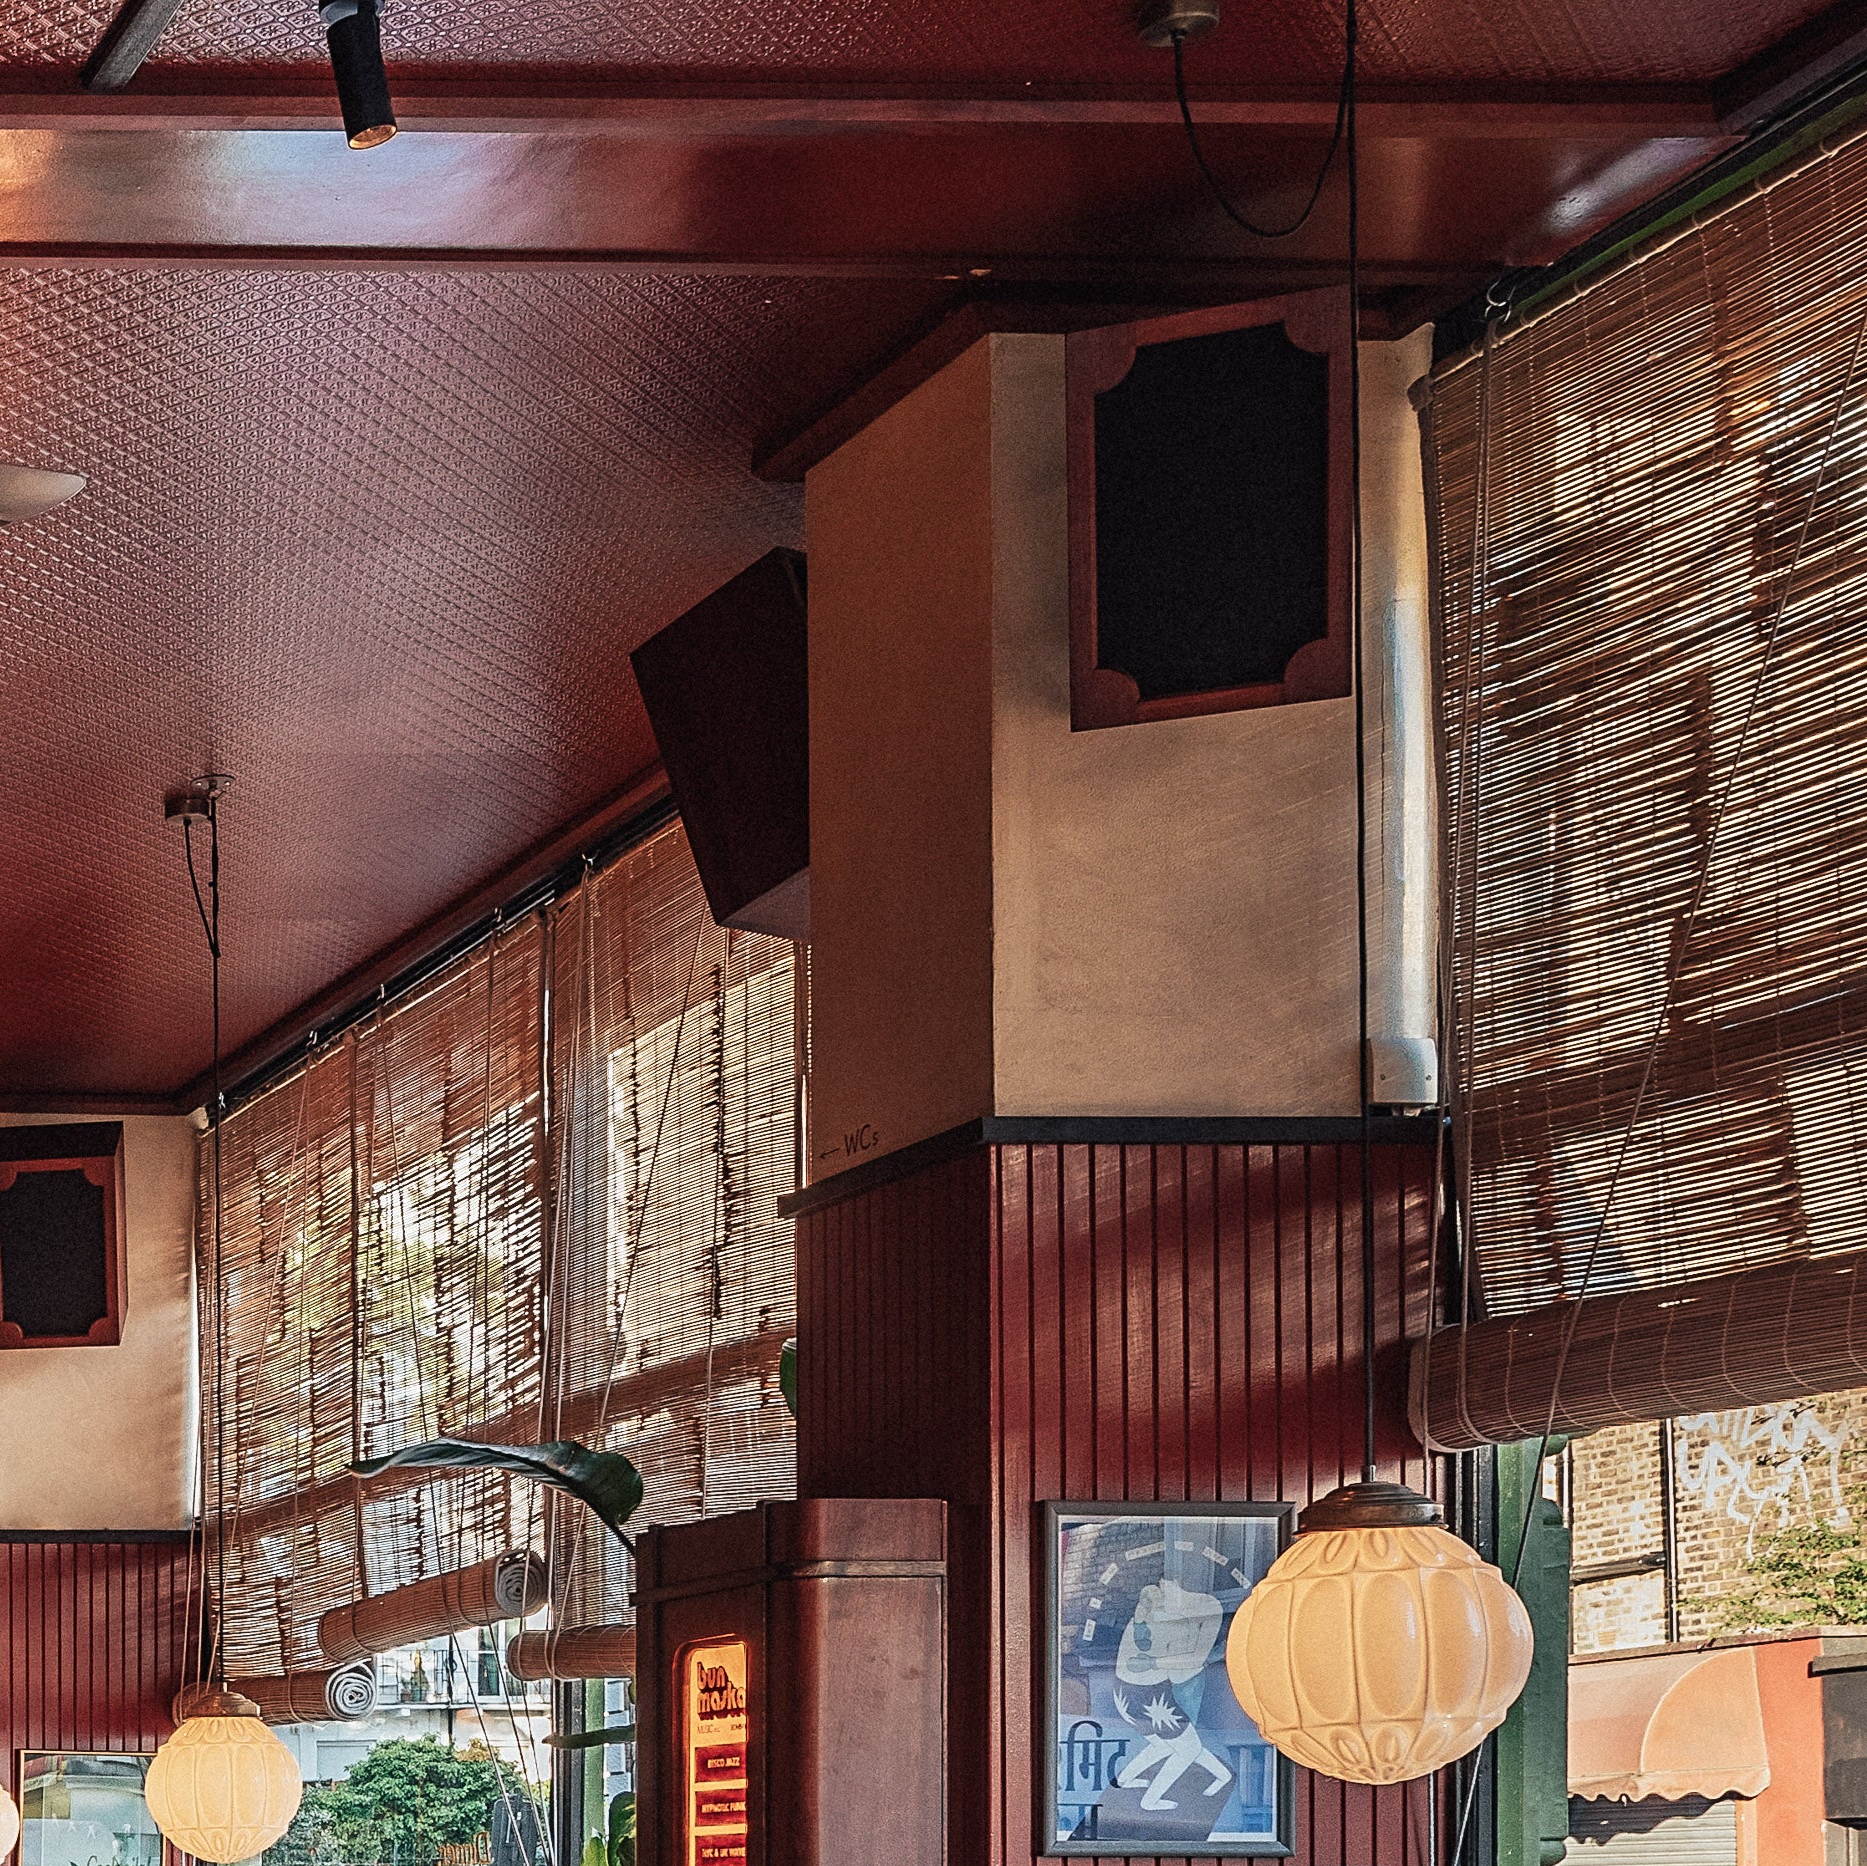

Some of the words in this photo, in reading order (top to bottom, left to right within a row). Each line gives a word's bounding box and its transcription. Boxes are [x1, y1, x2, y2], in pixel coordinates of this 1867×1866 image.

[844, 1124, 879, 1156] WCs
[696, 1661, 728, 1692] bun
[696, 1680, 747, 1720] maska
[707, 1759, 724, 1769] DISCO
[725, 1757, 740, 1767] JAZZ
